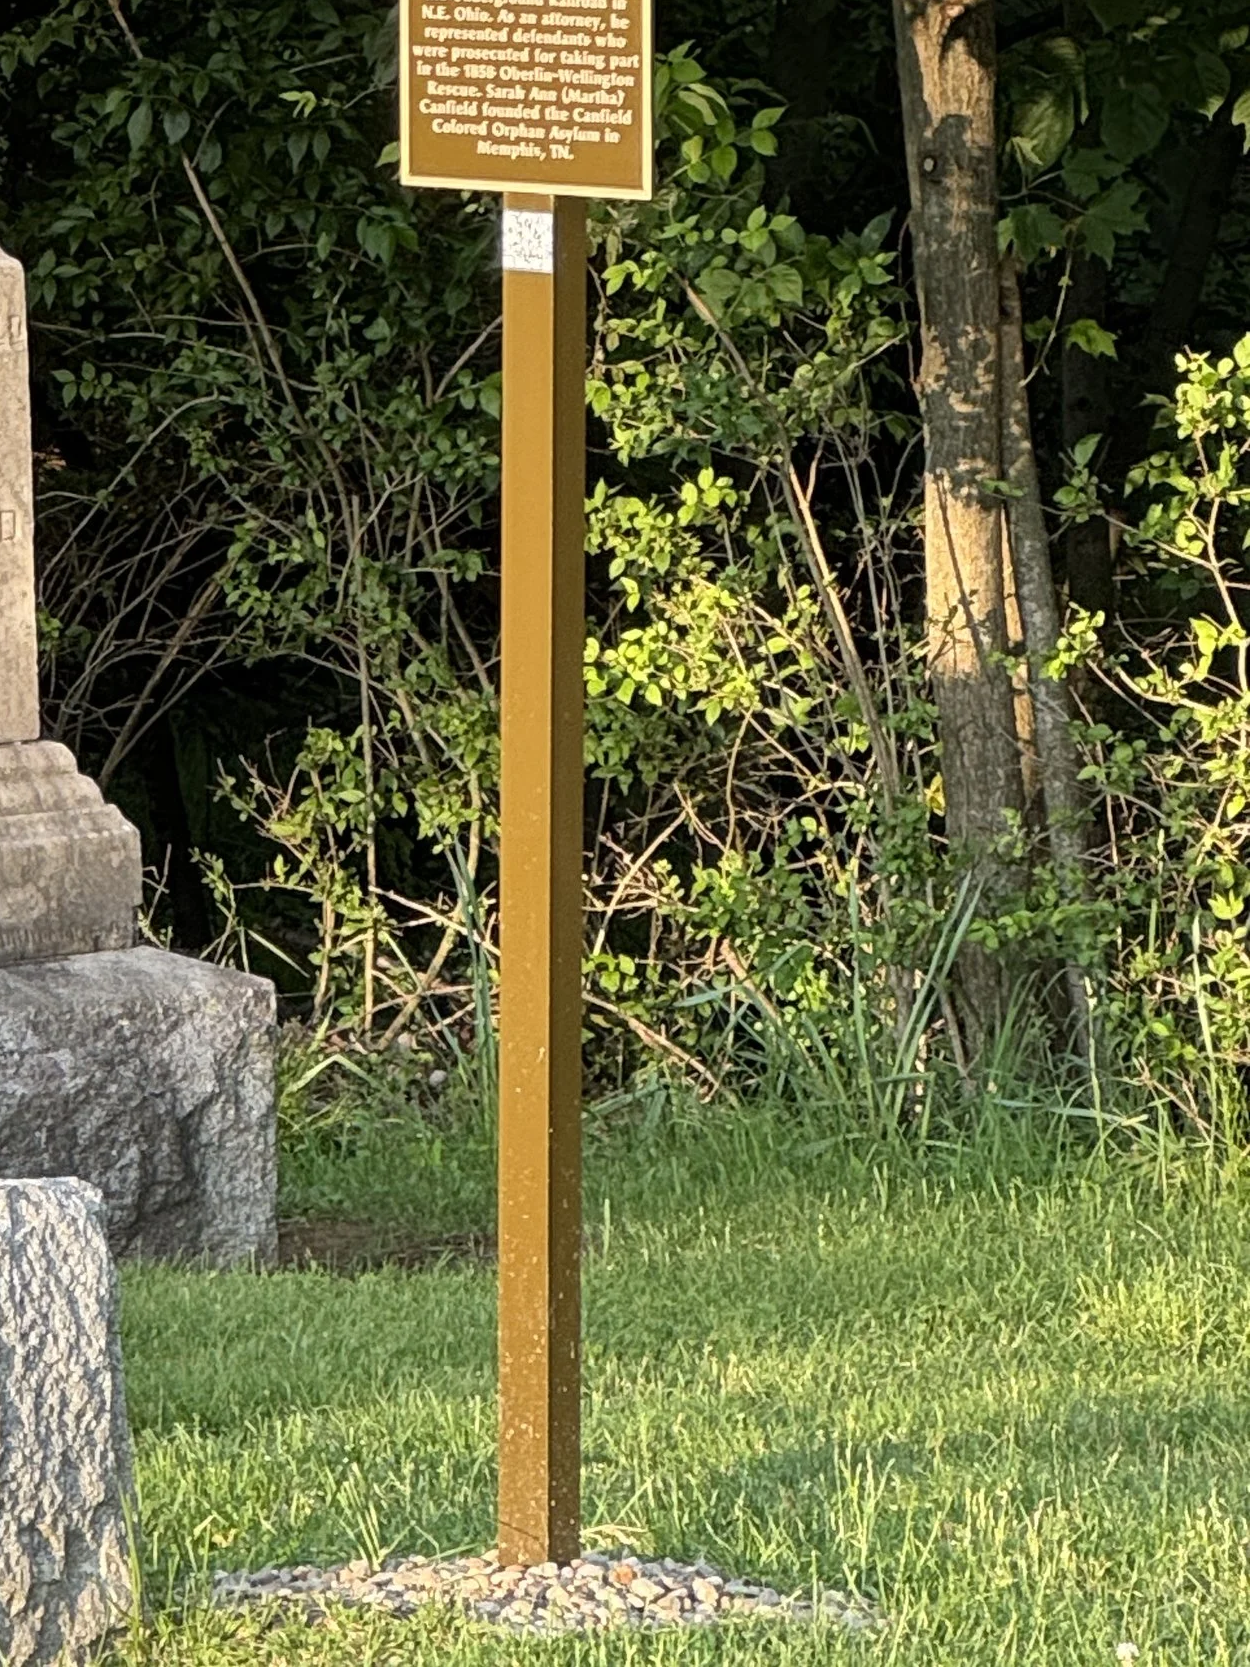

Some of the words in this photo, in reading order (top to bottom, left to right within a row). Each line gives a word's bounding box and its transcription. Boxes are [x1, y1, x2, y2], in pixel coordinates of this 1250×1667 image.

[422, 4, 451, 20] N.E.
[454, 6, 494, 23] Ohio.
[497, 9, 515, 23] As
[519, 16, 538, 25] an
[541, 11, 606, 32] attorney,
[610, 13, 630, 29] he
[424, 26, 509, 42] represented
[513, 28, 592, 46] defendants
[595, 32, 628, 48] who
[413, 44, 449, 57] were
[451, 46, 530, 63] prosecuted
[534, 48, 557, 64] for
[560, 50, 606, 69] taking
[609, 54, 640, 70] part
[416, 60, 433, 76] in
[436, 62, 461, 77] the
[464, 64, 497, 79] 1858
[500, 66, 635, 90] Oberlin-Wellington
[427, 80, 483, 97] Rescue.
[486, 84, 526, 100] Sarah
[529, 86, 557, 101] Ann
[561, 87, 625, 107] (Martha)
[419, 99, 478, 116] Canfield
[482, 102, 540, 120] founded
[545, 107, 569, 121] the
[573, 107, 632, 125] Canfield
[432, 119, 488, 135] Colored
[492, 122, 545, 141] Orphan
[549, 125, 600, 143] Asylum
[605, 128, 621, 144] in
[477, 140, 546, 161] Memphis,
[549, 144, 574, 160] TN.
